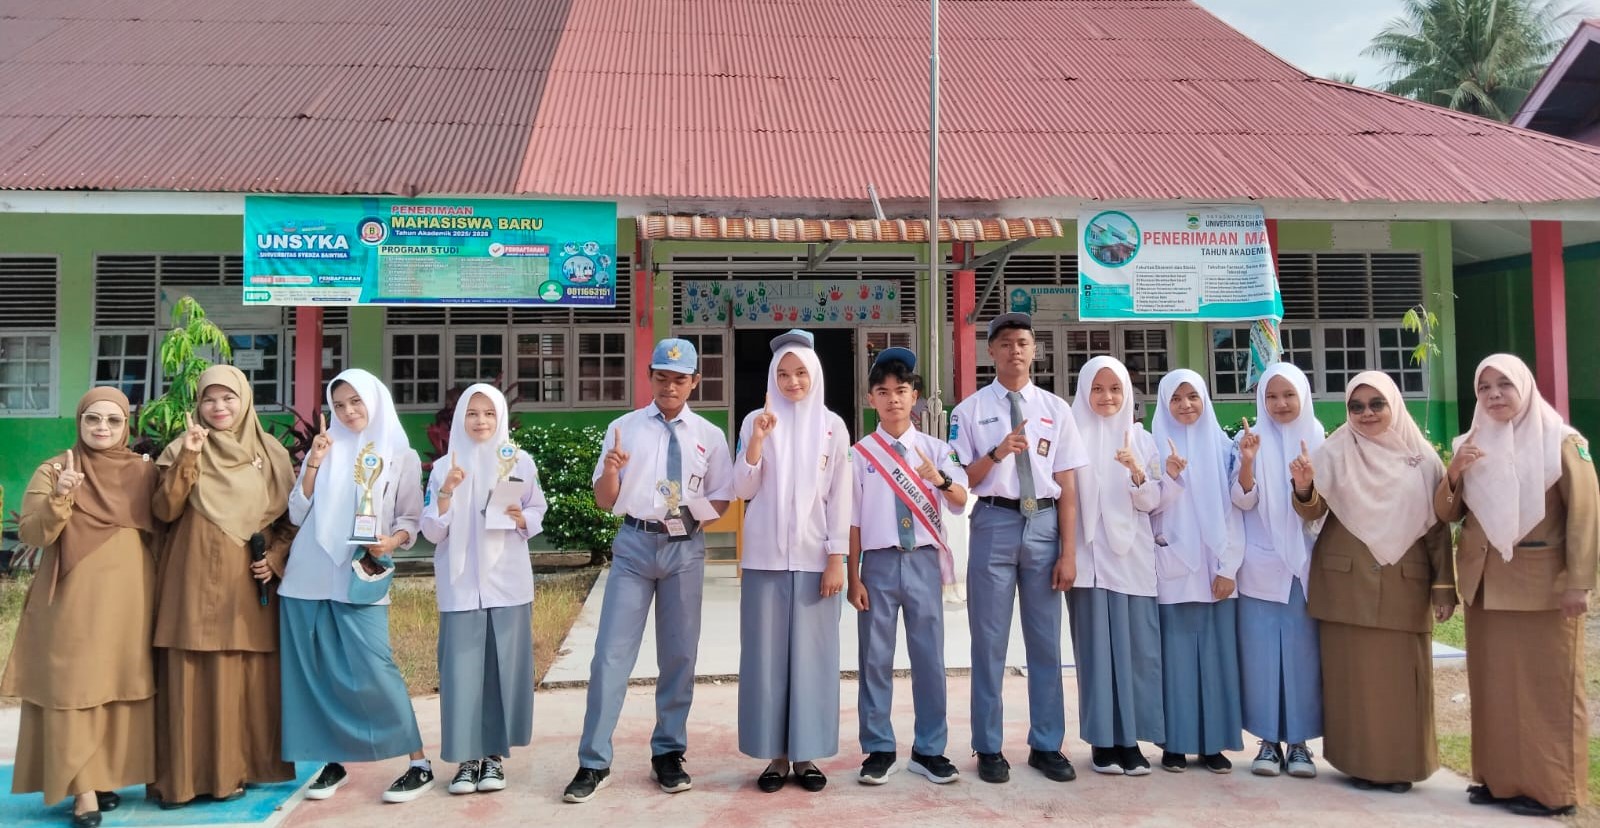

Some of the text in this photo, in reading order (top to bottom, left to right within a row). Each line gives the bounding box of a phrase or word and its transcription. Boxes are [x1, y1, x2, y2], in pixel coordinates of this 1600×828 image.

[391, 205, 473, 215] PENERIMAAN
[391, 216, 543, 231] MAHASISWA BARU
[1205, 220, 1245, 229] UNIVERSITAS
[257, 234, 349, 250] UNSYKA
[1143, 231, 1238, 246] PENERIMAAN
[381, 246, 459, 255] PROGRAM STUDI
[1201, 247, 1228, 256] TAHUN
[892, 468, 925, 504] PETUGAS
